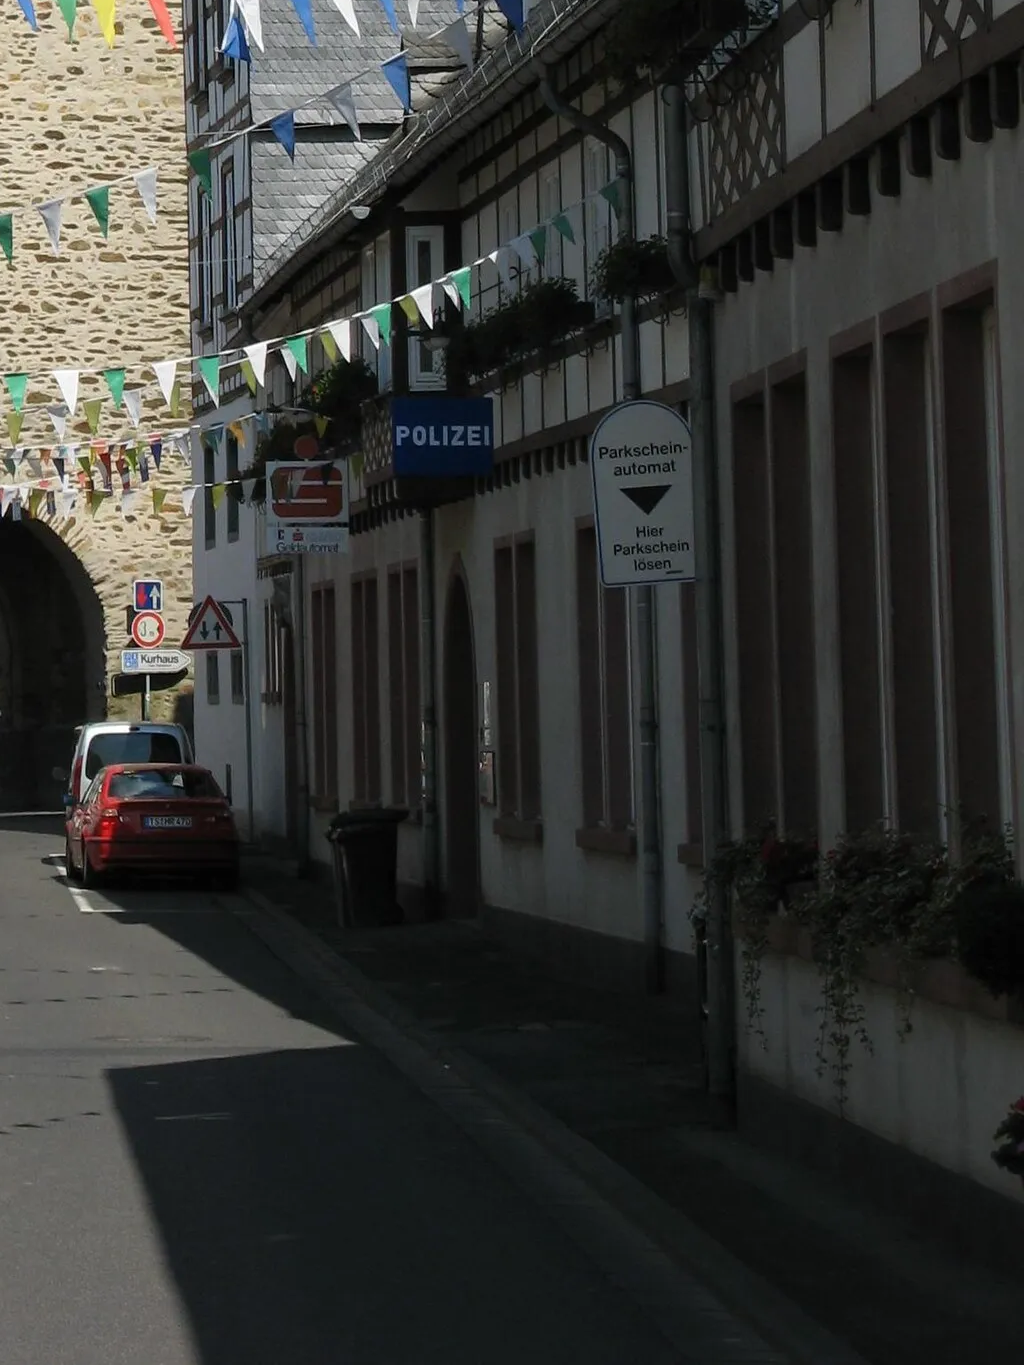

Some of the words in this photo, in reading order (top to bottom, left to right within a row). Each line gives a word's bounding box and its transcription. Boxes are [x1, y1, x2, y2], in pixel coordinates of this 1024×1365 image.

[396, 425, 490, 446] POLIZEI
[598, 441, 689, 460] Parkschein-
[613, 460, 677, 477] automat
[636, 525, 664, 538] Hier
[613, 540, 690, 556] Parkschein
[633, 559, 672, 572] lösen
[140, 653, 179, 664] Kurhaus
